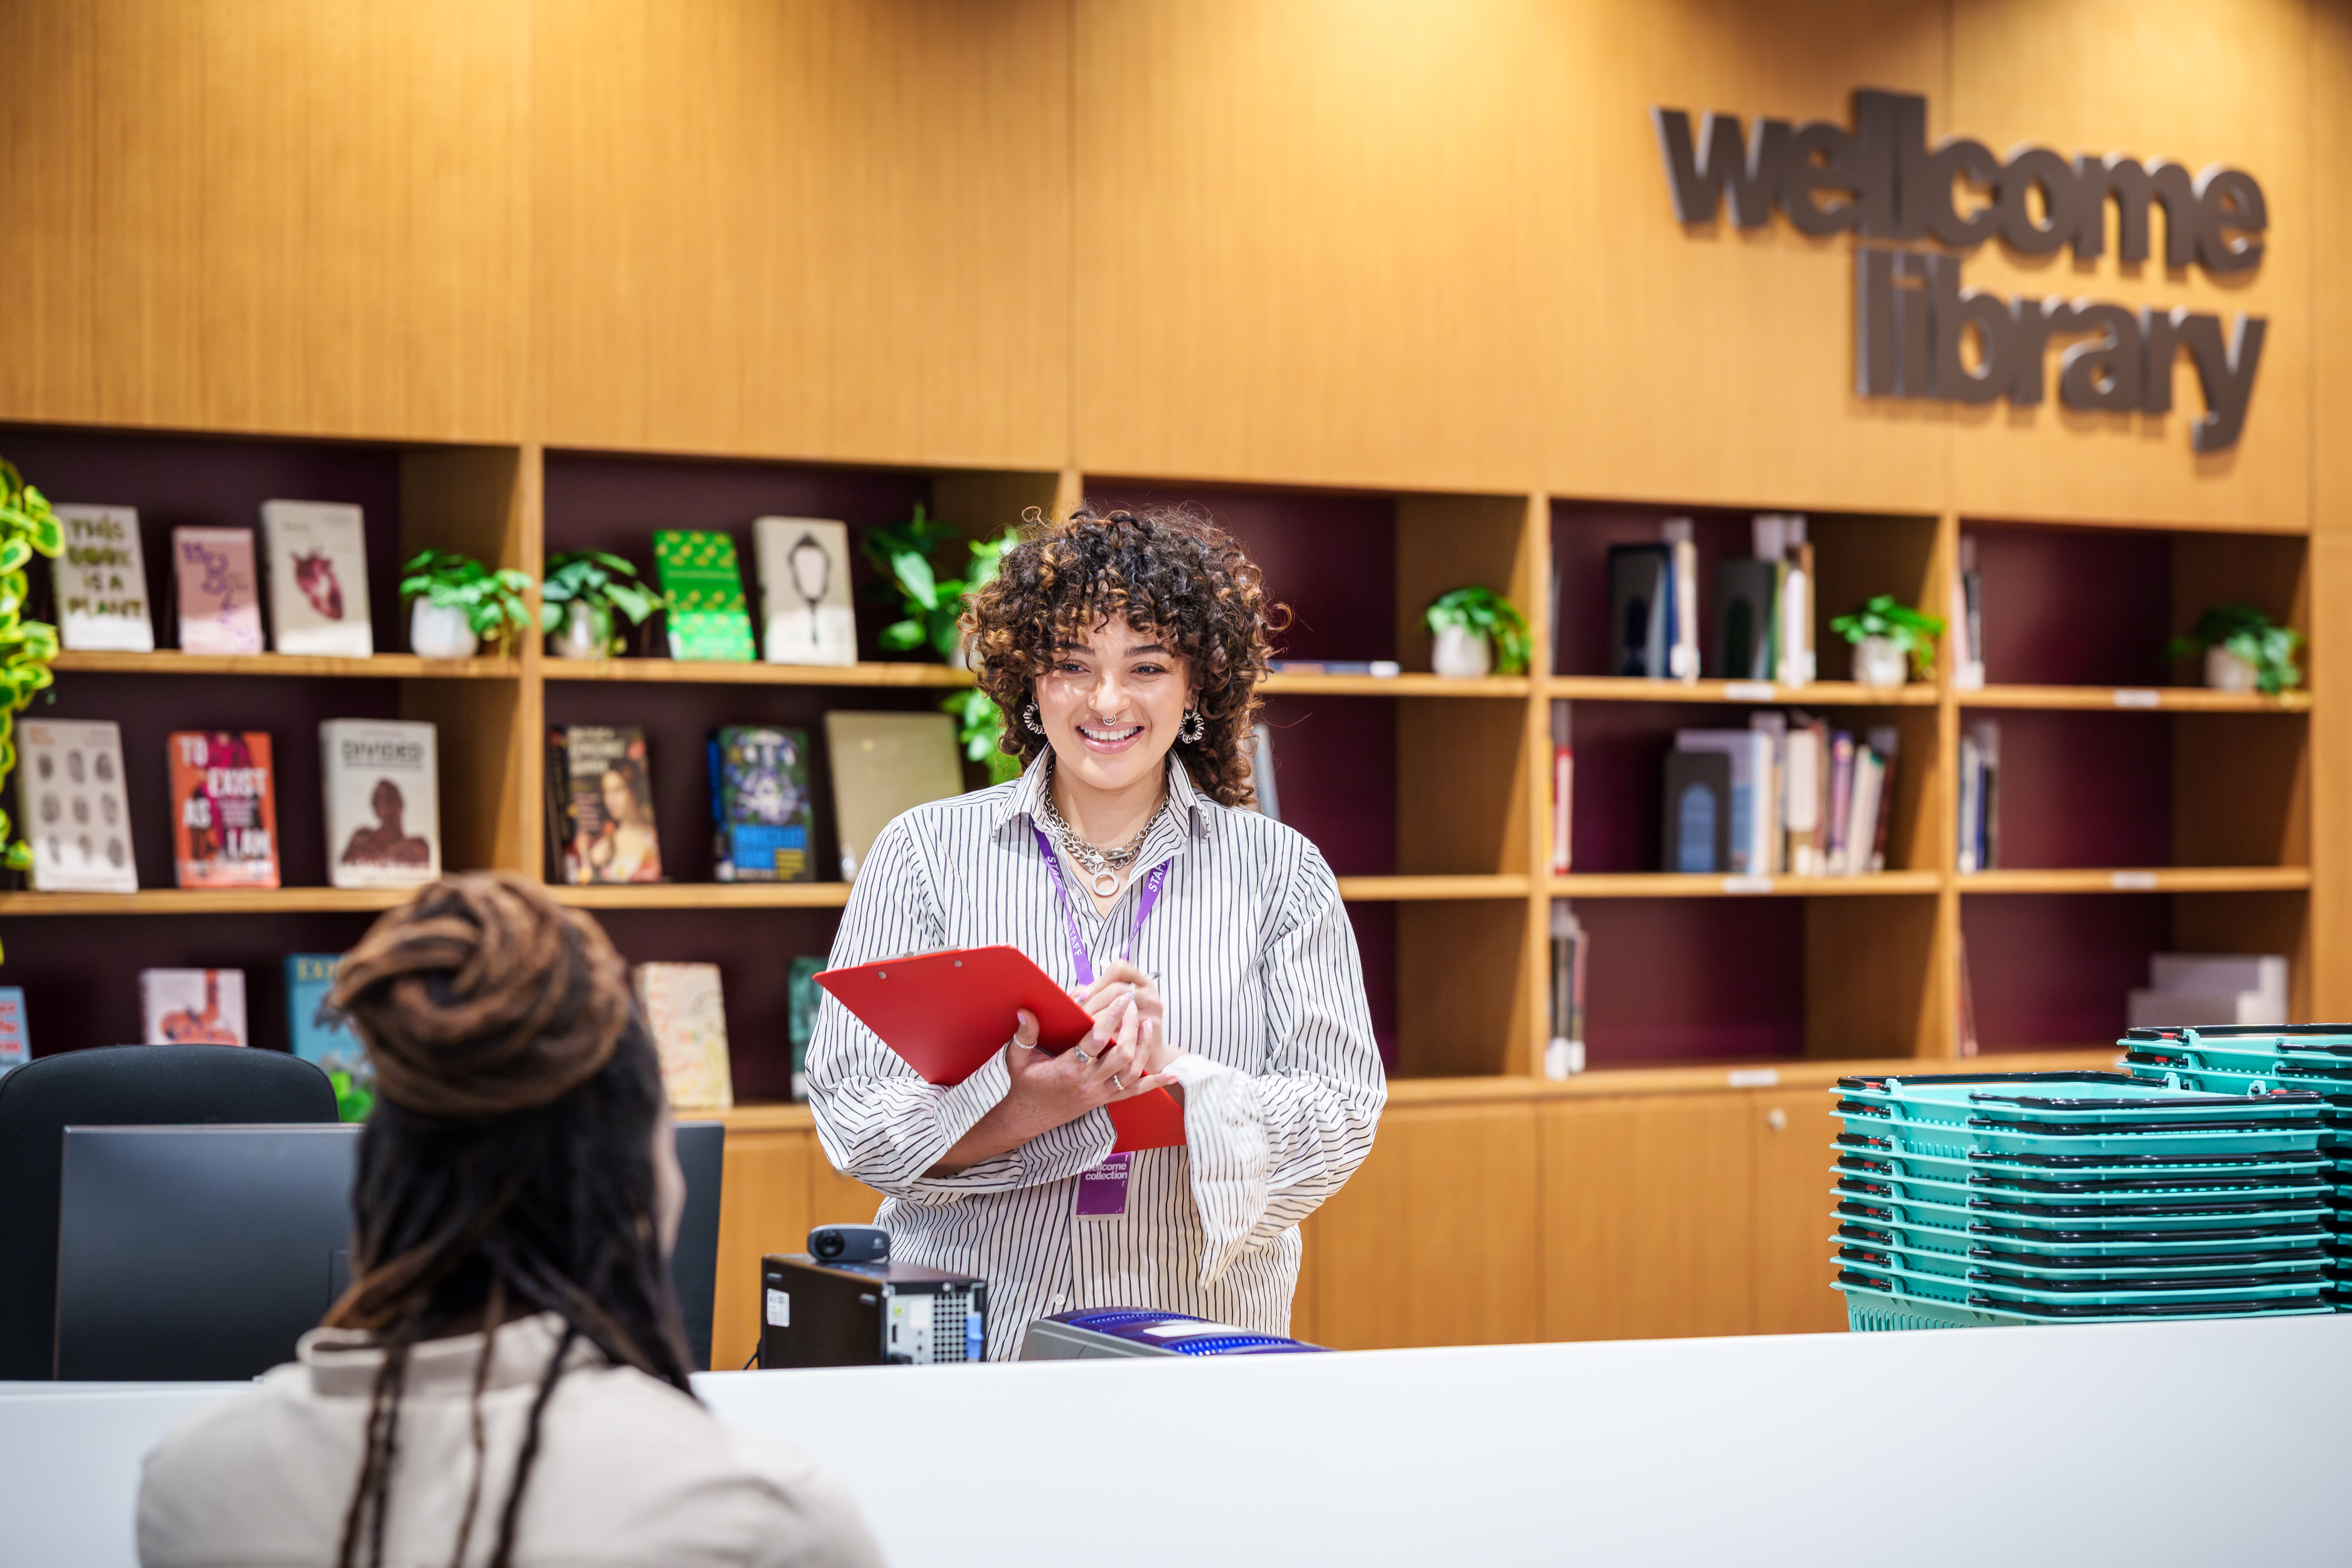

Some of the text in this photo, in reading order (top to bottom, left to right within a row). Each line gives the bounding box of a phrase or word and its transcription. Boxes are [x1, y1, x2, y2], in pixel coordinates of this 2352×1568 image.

[1651, 88, 2269, 275] wellcome
[1856, 245, 2269, 453] library
[179, 735, 209, 767] TO
[183, 797, 212, 828] AS
[1047, 855, 1064, 891] STAFF
[1068, 921, 1083, 957] STAFF
[1085, 1170, 1128, 1181] collection
[1088, 1163, 1127, 1172] ellcome
